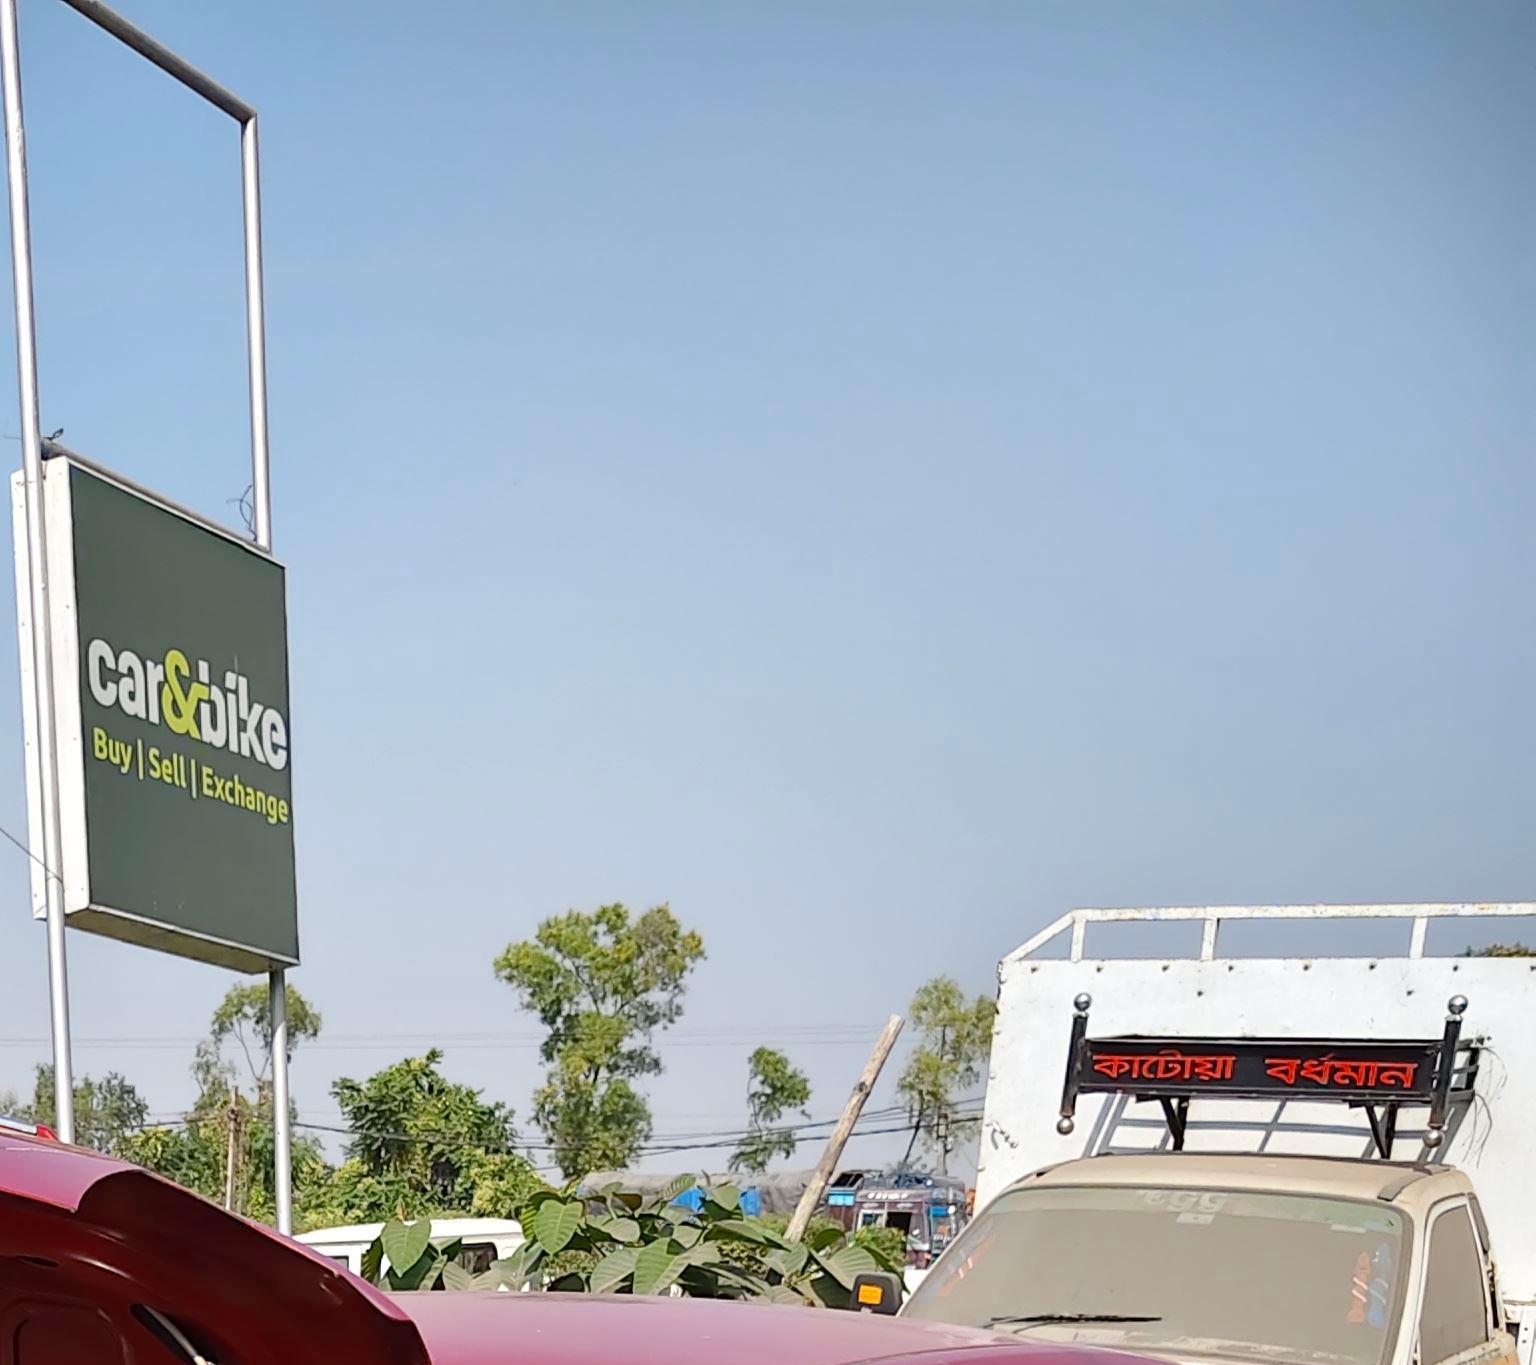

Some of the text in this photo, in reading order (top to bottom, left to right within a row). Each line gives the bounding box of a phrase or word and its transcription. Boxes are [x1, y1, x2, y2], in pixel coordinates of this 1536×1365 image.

[88, 638, 288, 770] car&bike
[92, 727, 288, 825] Buy Sell Exchange
[1092, 1048, 1418, 1089] কাটোয়া বর্ধমান
